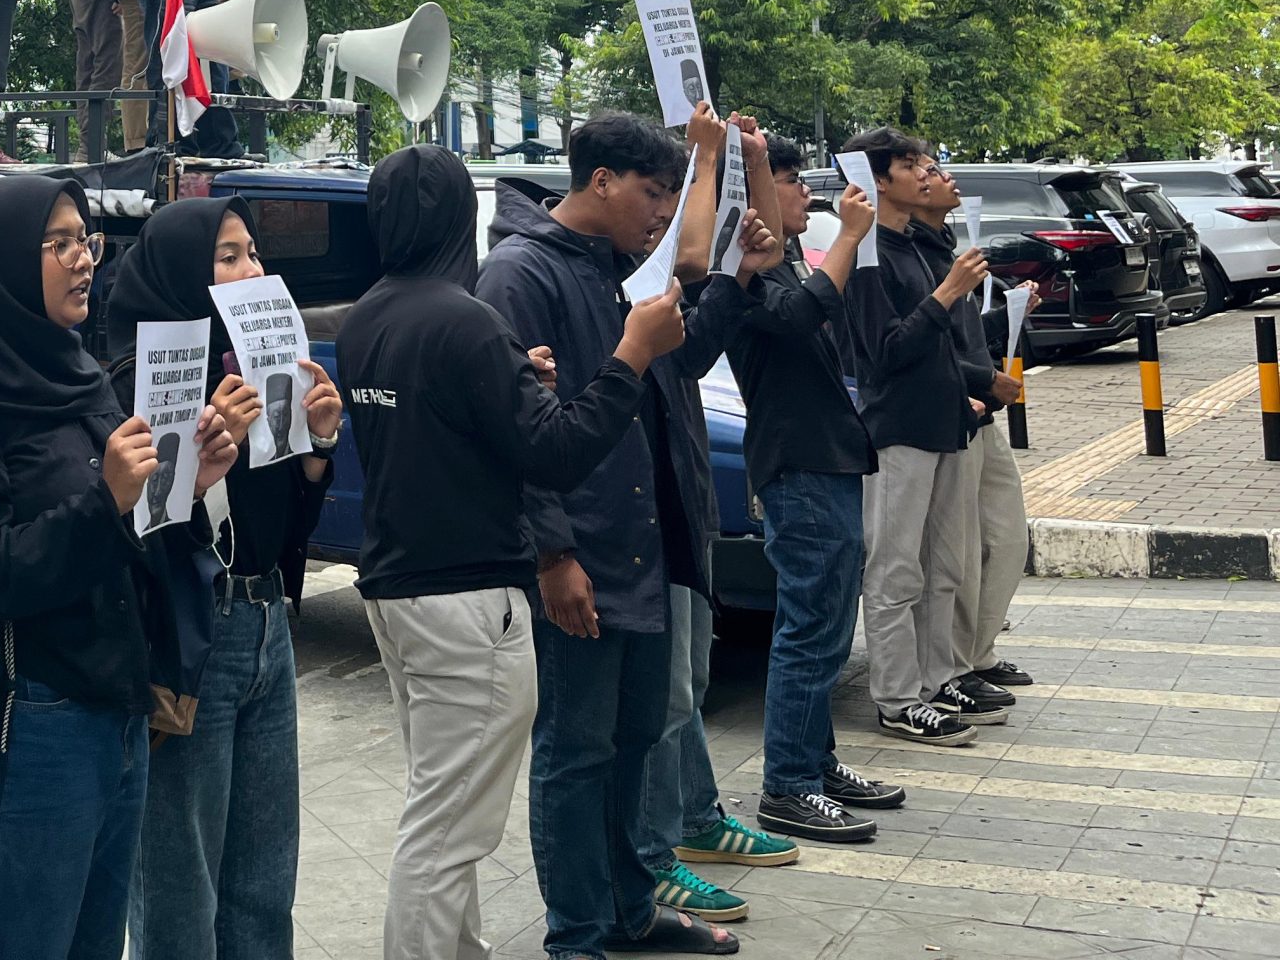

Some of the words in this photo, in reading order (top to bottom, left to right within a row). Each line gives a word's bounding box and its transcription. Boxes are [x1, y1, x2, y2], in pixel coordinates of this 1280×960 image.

[229, 304, 248, 316] USUT
[248, 300, 272, 313] TUNTAS
[240, 319, 272, 333] KELUARGA
[148, 351, 166, 364] USUT
[168, 348, 189, 363] TUNTAS
[252, 357, 258, 368] DI
[259, 354, 276, 368] JAWA
[152, 370, 181, 385] KELUARGA
[150, 413, 156, 427] DI
[157, 411, 173, 426] JAWA
